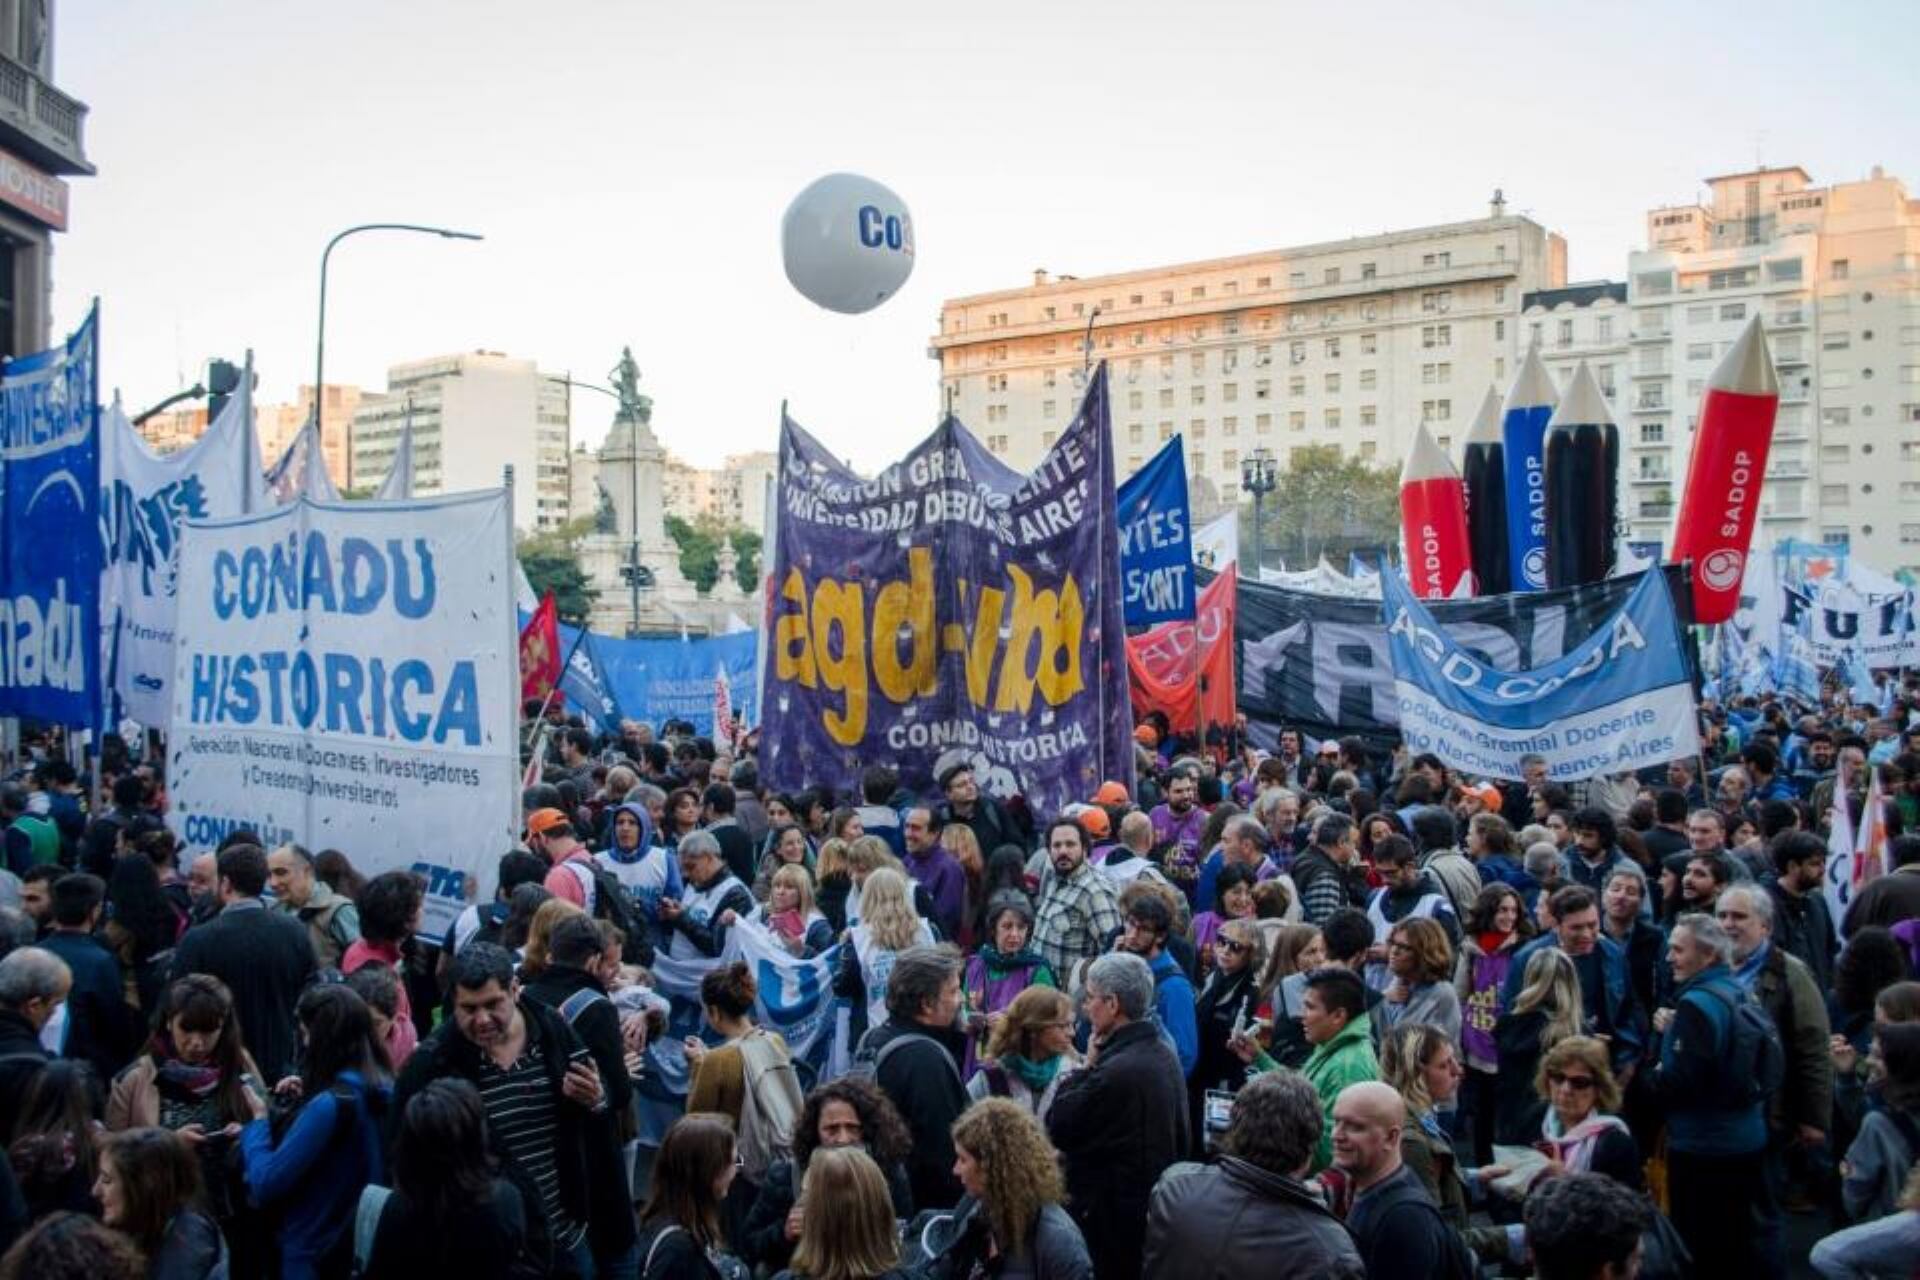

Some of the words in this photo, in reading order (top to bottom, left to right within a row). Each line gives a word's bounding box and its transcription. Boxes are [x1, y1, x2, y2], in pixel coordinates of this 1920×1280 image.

[1526, 456, 1545, 537] SADOP
[1721, 450, 1755, 538] SADOP
[213, 529, 436, 621] CONADU
[1423, 525, 1440, 599] SADOP
[887, 719, 980, 750] CONAD
[1565, 706, 1656, 747] Docente
[1617, 733, 1675, 762] Aires
